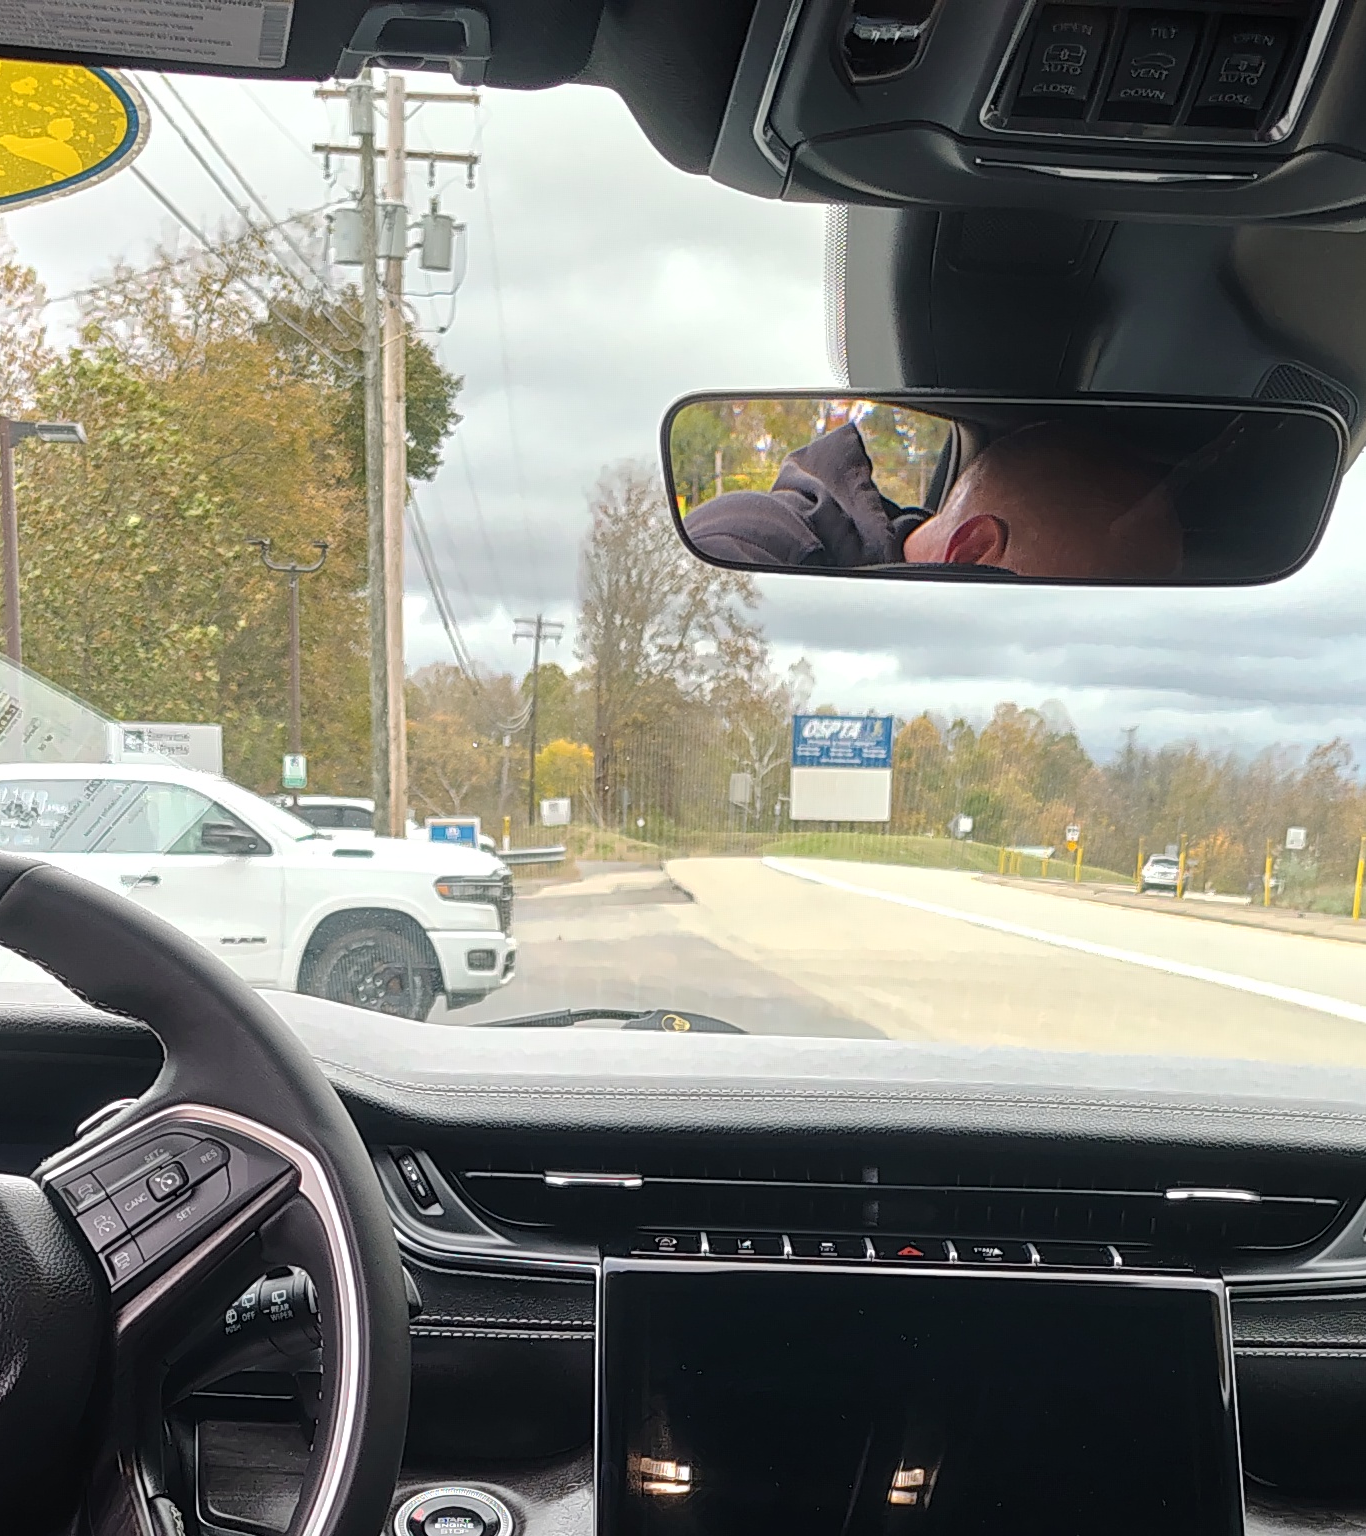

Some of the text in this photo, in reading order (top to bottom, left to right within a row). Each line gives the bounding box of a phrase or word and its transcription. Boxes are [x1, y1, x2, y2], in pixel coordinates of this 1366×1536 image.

[1052, 23, 1092, 36] OPEN
[1150, 26, 1178, 40] TILT
[1233, 33, 1276, 47] OPEN
[1042, 64, 1082, 76] AUTO
[1131, 68, 1169, 81] VENT
[1219, 73, 1258, 86] AUTO
[1033, 84, 1076, 96] CLOSE
[1120, 88, 1166, 100] DOWN
[1209, 93, 1251, 105] CLOSE
[200, 1149, 218, 1165] RES
[124, 1192, 149, 1212] CANC
[271, 1303, 289, 1313] REAR
[241, 1310, 256, 1321] OFF
[270, 1310, 293, 1321] WIPER
